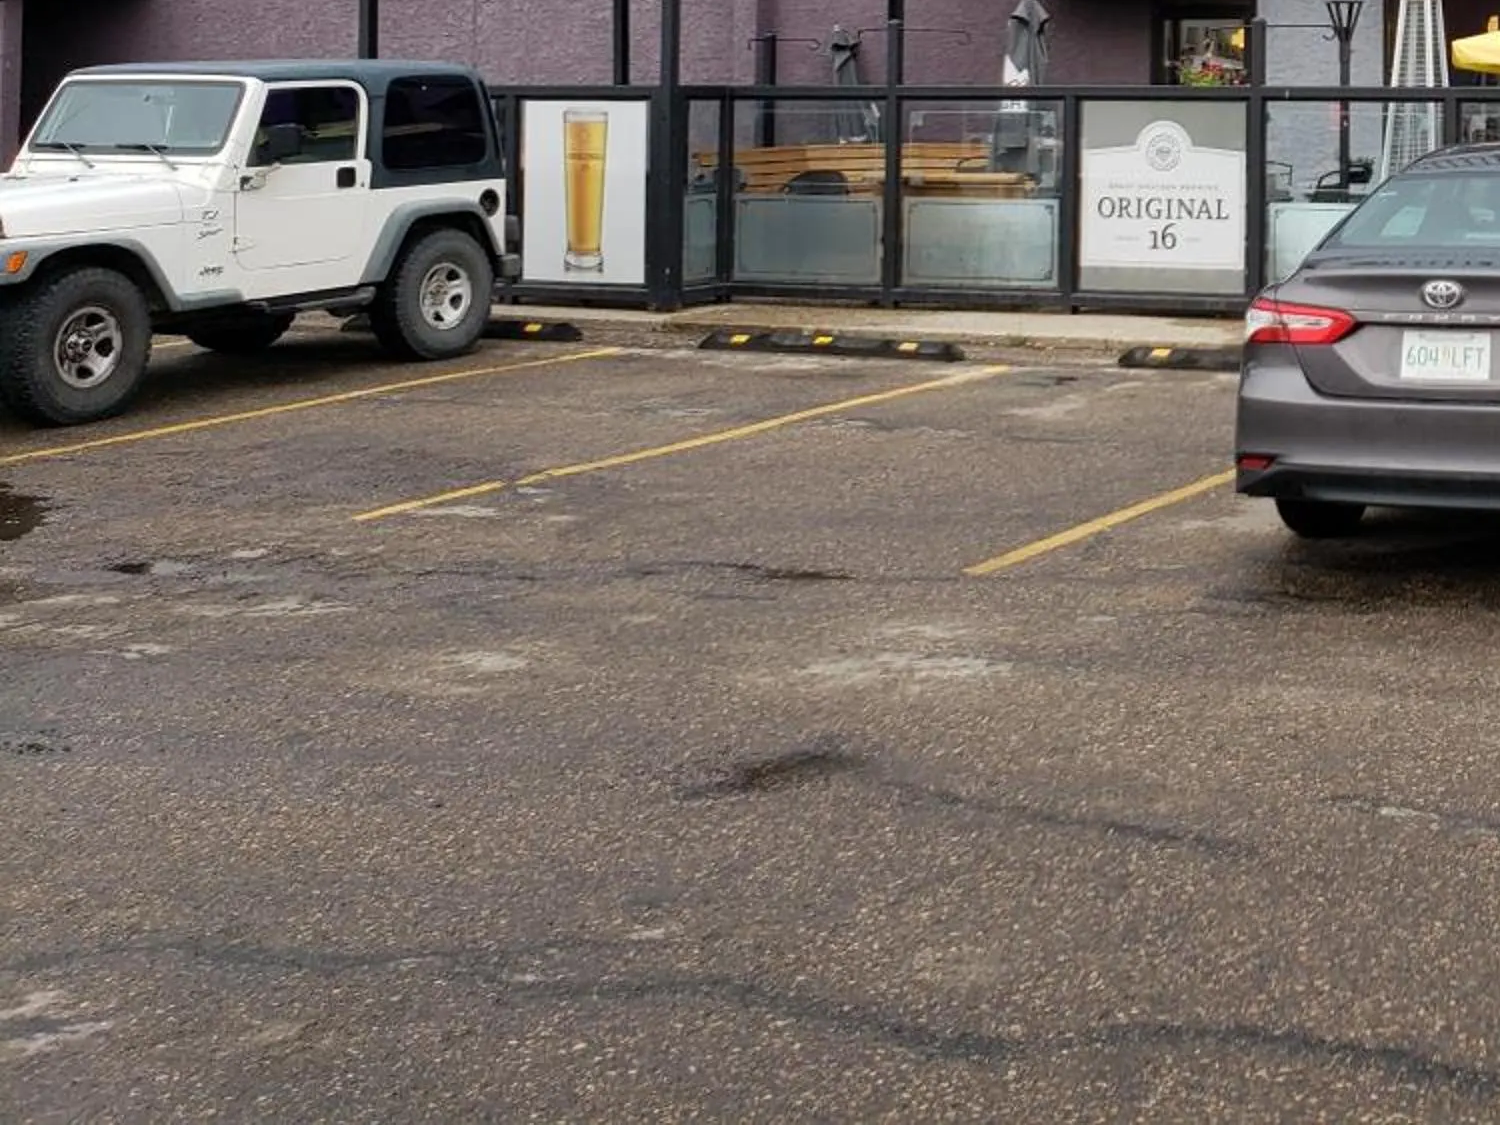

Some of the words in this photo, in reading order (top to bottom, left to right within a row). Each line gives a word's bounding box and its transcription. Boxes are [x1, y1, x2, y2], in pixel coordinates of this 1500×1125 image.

[1098, 196, 1230, 221] ORIGINAL
[1149, 223, 1177, 250] 16
[1406, 345, 1440, 367] 604
[1451, 346, 1485, 370] LFT
